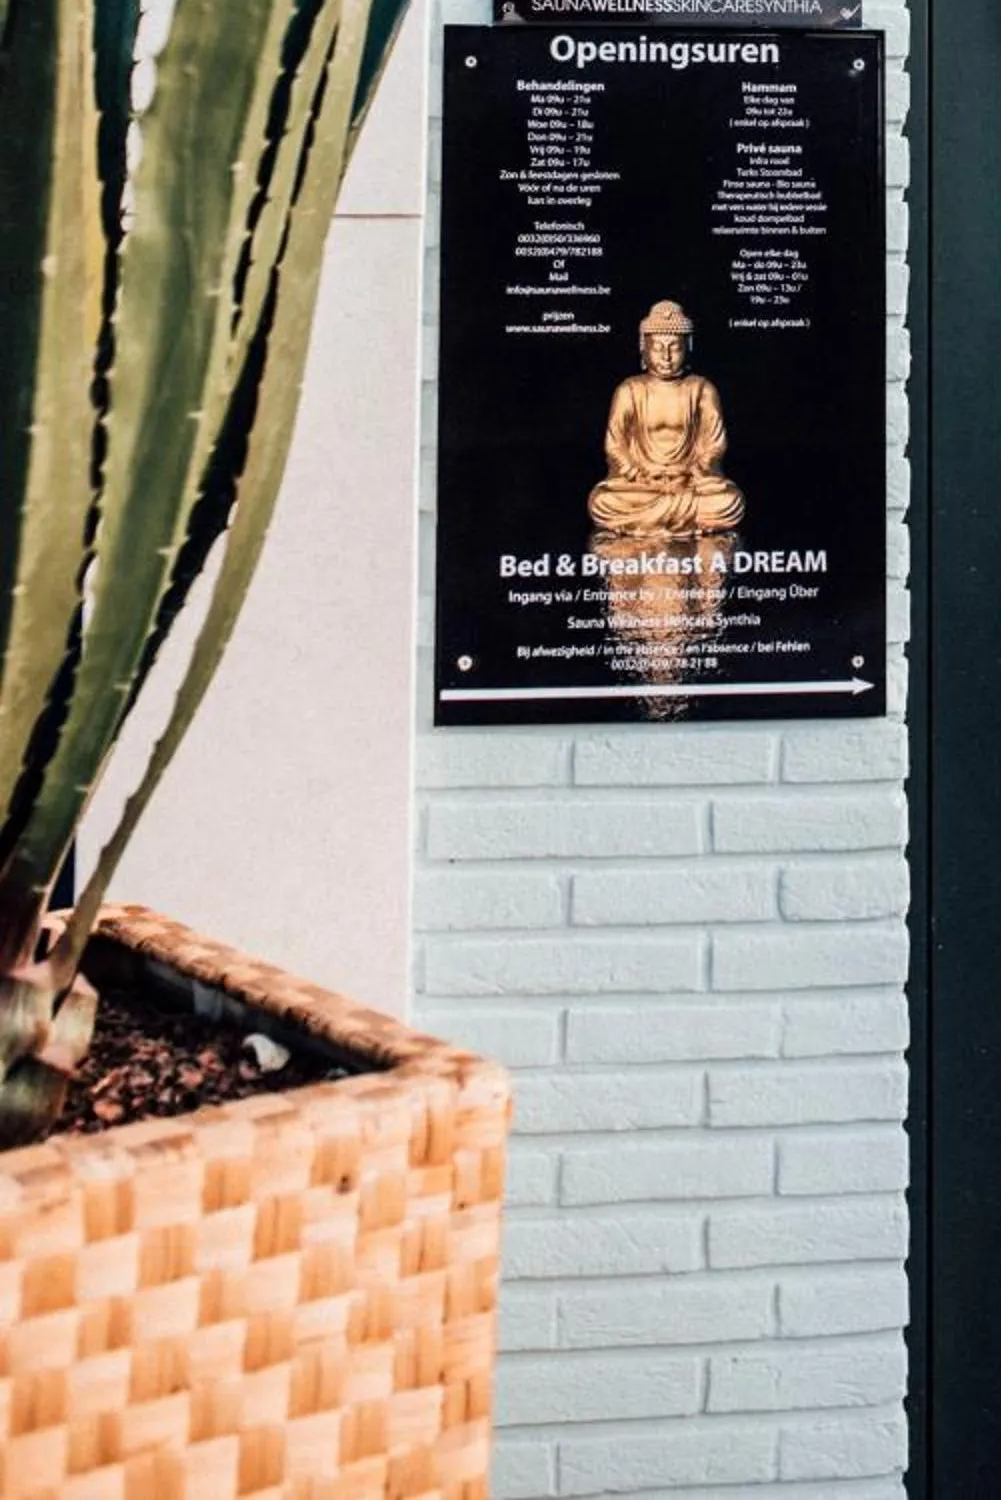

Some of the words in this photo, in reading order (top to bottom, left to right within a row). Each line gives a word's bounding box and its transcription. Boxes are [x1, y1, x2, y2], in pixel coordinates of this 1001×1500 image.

[550, 34, 780, 69] Openingsuren
[516, 79, 605, 93] Behandelingen
[741, 81, 797, 93] Hammam
[736, 142, 766, 154] Privé
[768, 145, 802, 154] sauna
[500, 170, 518, 180] Zon
[500, 553, 550, 577] Bed
[555, 553, 576, 577] &
[581, 551, 703, 577] Breakfast
[710, 551, 727, 573] A
[734, 550, 828, 573] DREAM
[509, 589, 552, 606] Ingang
[554, 589, 573, 602] via
[737, 587, 787, 601] Eingang
[566, 616, 605, 629] Sauna
[758, 642, 774, 653] bei
[775, 641, 811, 653] Fehlen
